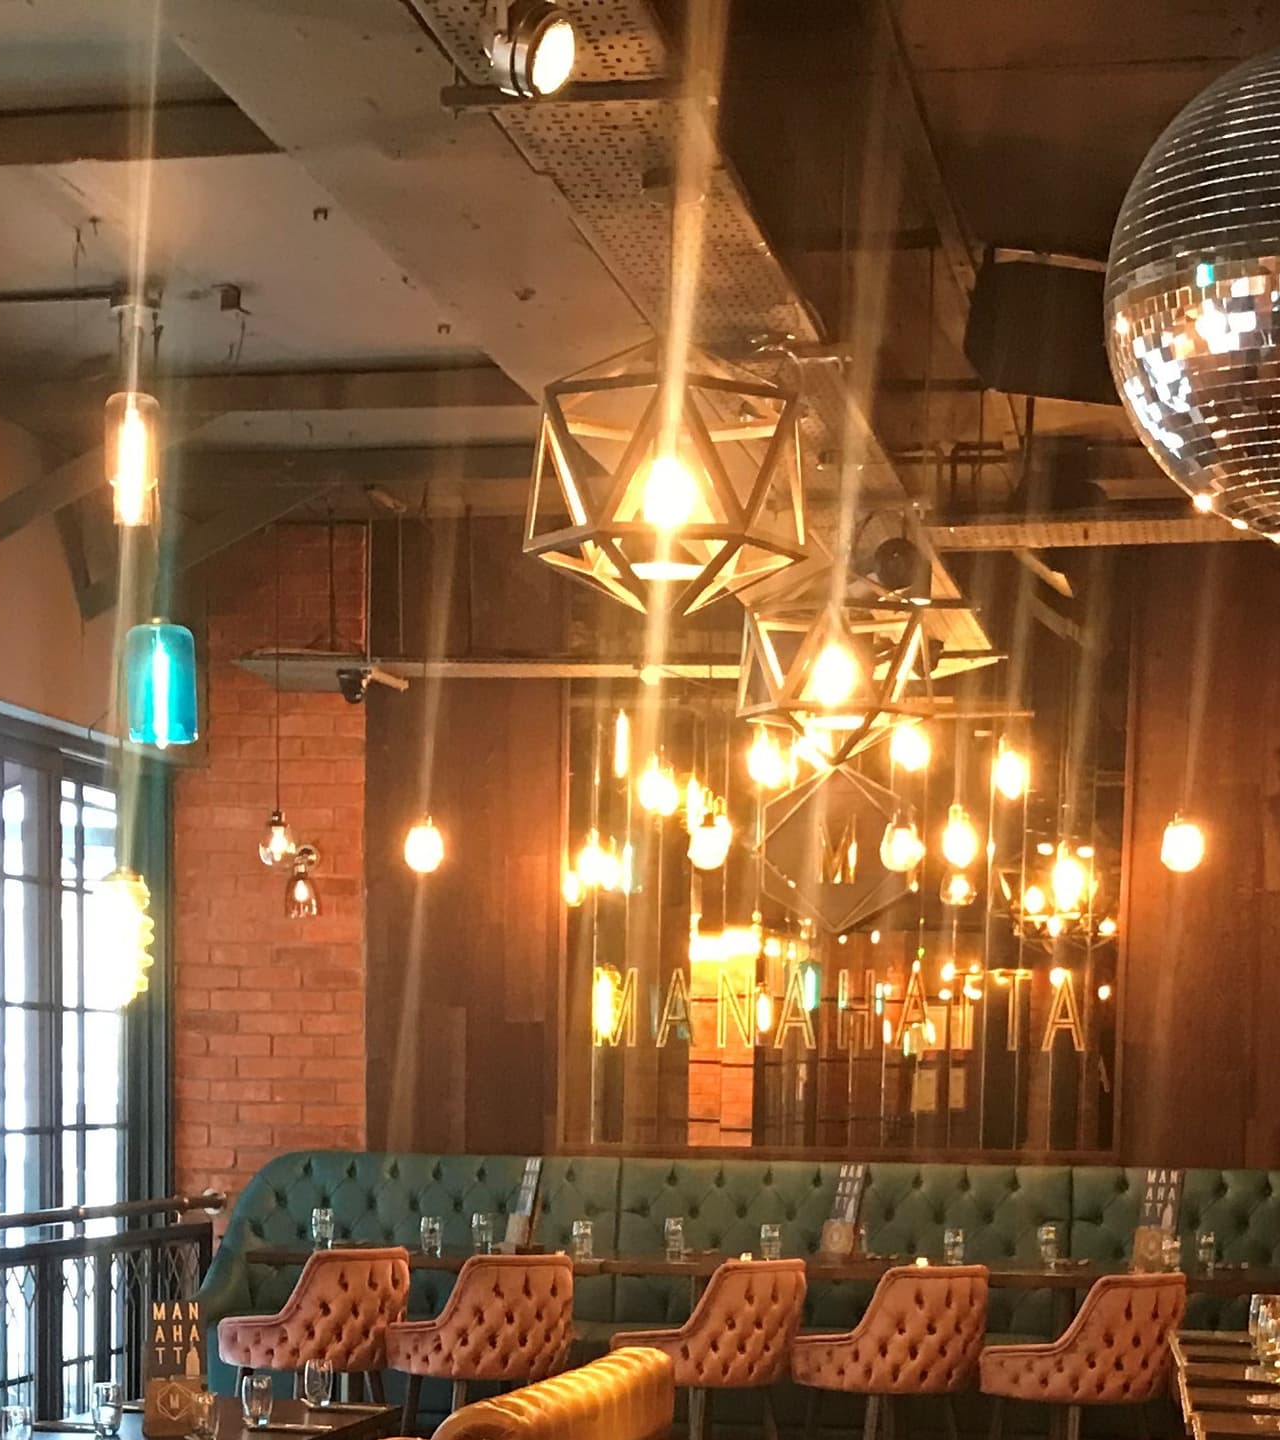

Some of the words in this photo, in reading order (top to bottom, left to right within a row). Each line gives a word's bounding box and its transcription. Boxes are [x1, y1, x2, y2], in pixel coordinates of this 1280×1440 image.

[152, 1301, 200, 1321] MAN
[155, 1324, 200, 1343] AHA
[155, 1346, 183, 1365] TT
